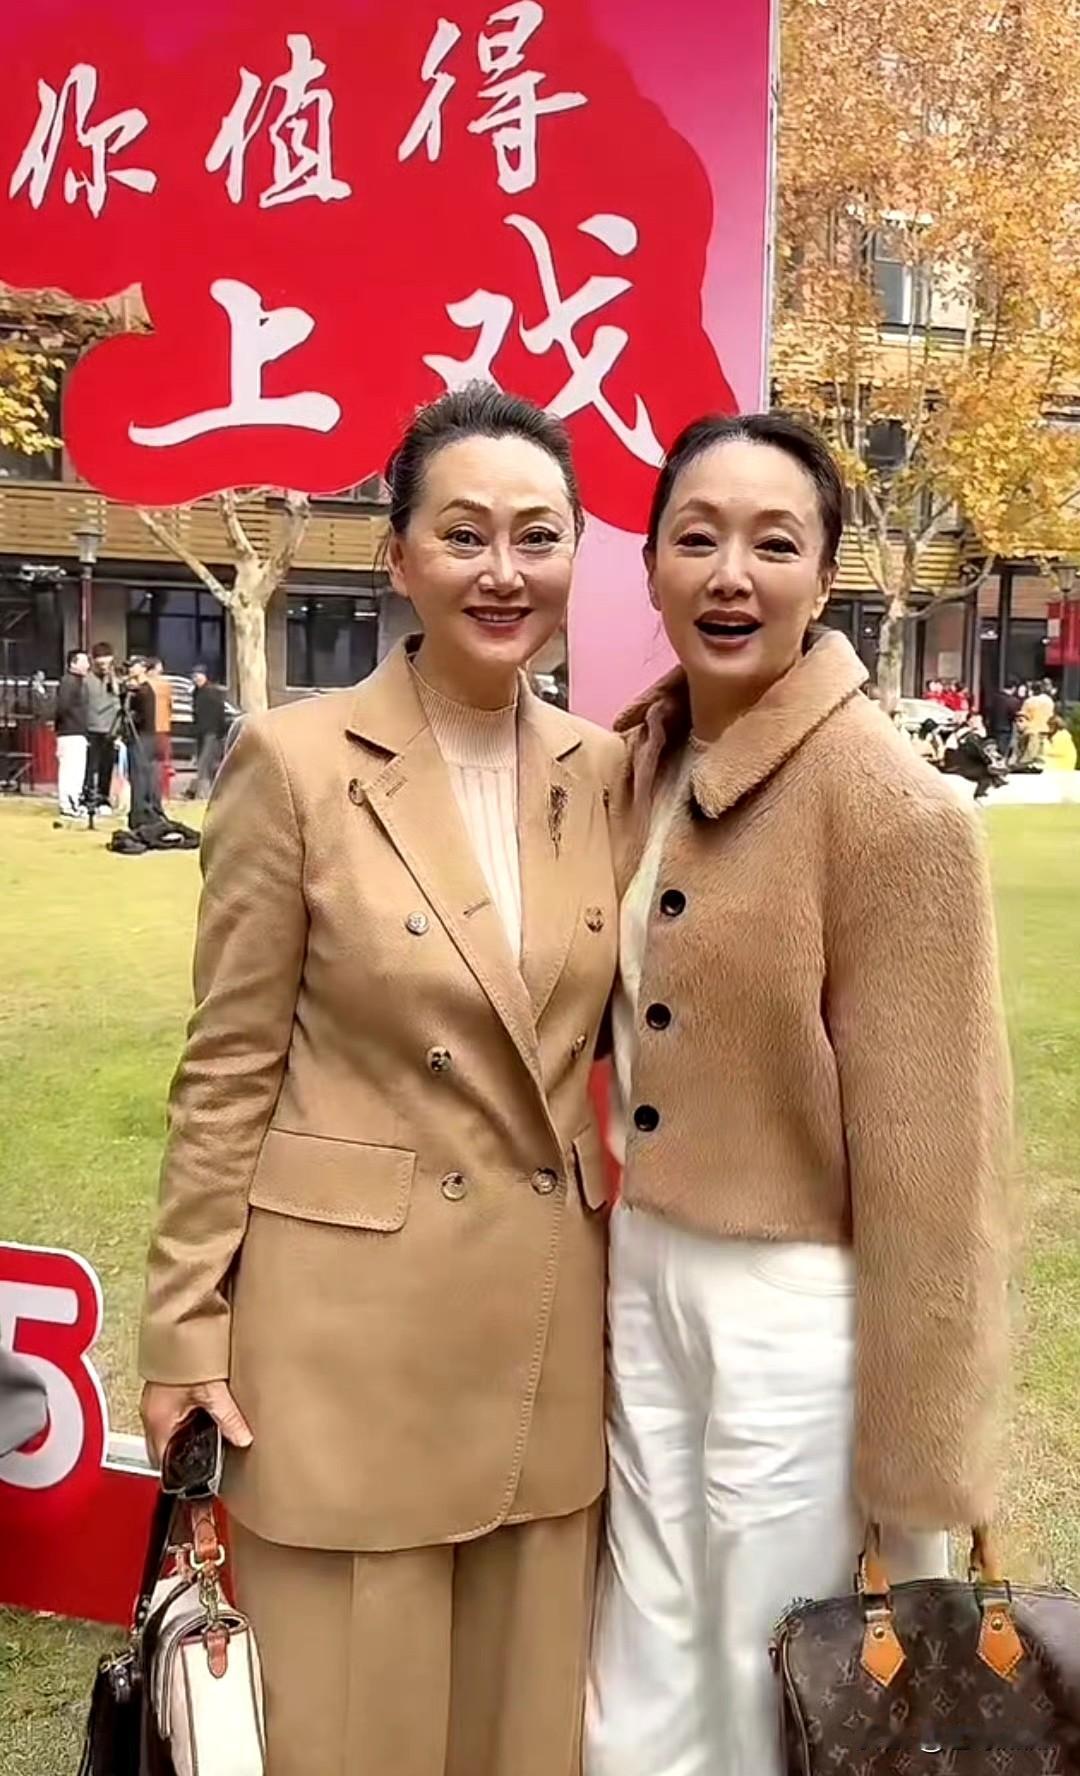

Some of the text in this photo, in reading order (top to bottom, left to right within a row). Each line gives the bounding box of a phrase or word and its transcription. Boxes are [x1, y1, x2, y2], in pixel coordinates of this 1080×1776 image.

[8, 0, 588, 219] 你值得
[128, 213, 663, 467] 上戏
